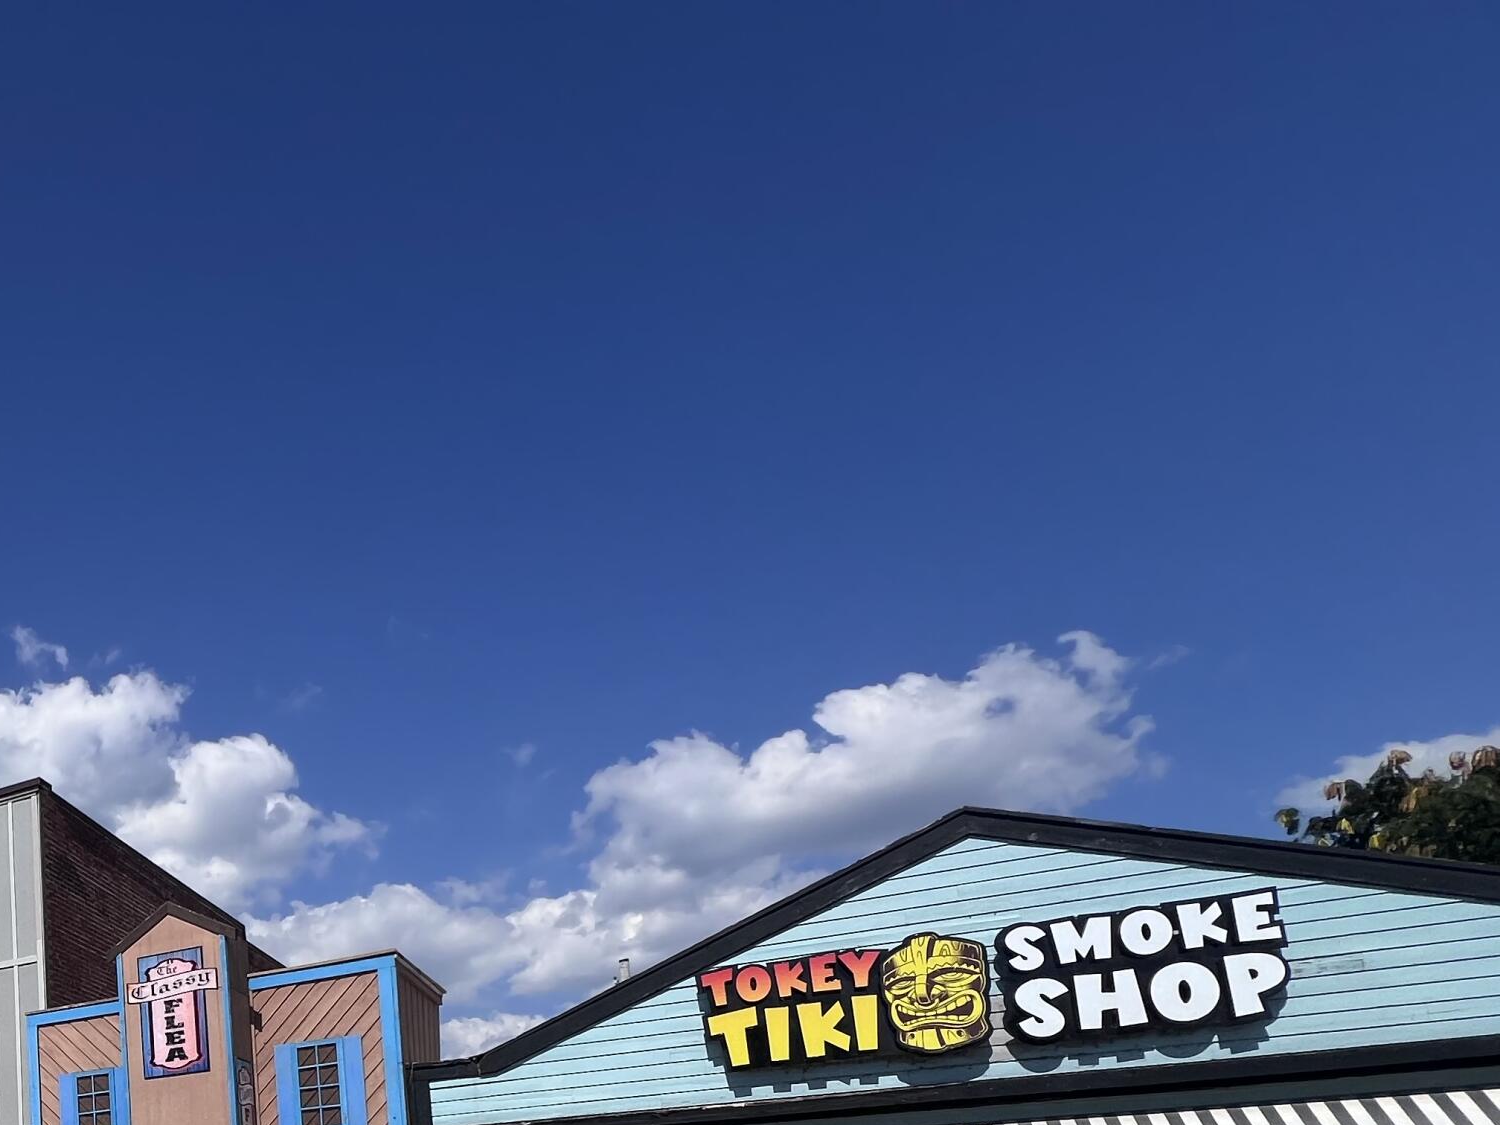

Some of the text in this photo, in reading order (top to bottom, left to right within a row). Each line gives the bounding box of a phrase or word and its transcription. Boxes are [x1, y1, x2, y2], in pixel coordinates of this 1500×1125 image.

[1003, 891, 1283, 971] SMOKE
[131, 971, 213, 1000] Classy
[156, 965, 178, 976] The
[701, 950, 882, 1006] TOKEY
[1013, 952, 1289, 1039] SHOP
[163, 998, 189, 1062] FLEA
[708, 994, 879, 1067] TIKI
